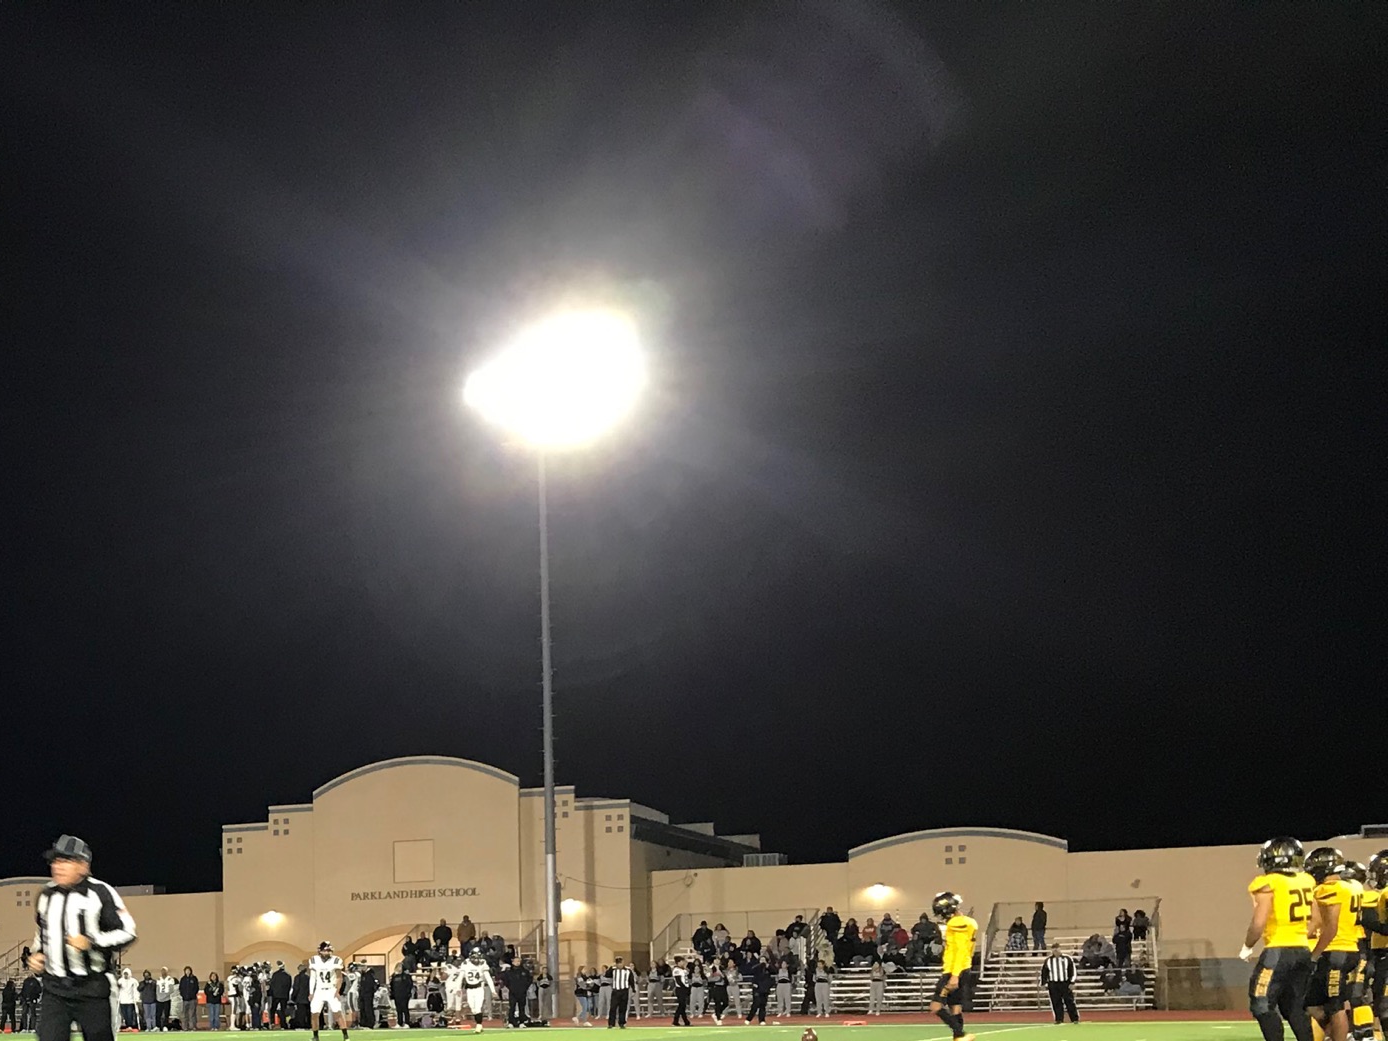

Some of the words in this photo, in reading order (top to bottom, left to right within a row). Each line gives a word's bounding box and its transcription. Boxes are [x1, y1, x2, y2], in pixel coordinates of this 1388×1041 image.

[350, 890, 409, 901] PARKLAND
[409, 889, 436, 899] HIGH
[437, 887, 480, 897] SCHOOL
[1289, 888, 1313, 922] 25
[467, 972, 480, 982] 24
